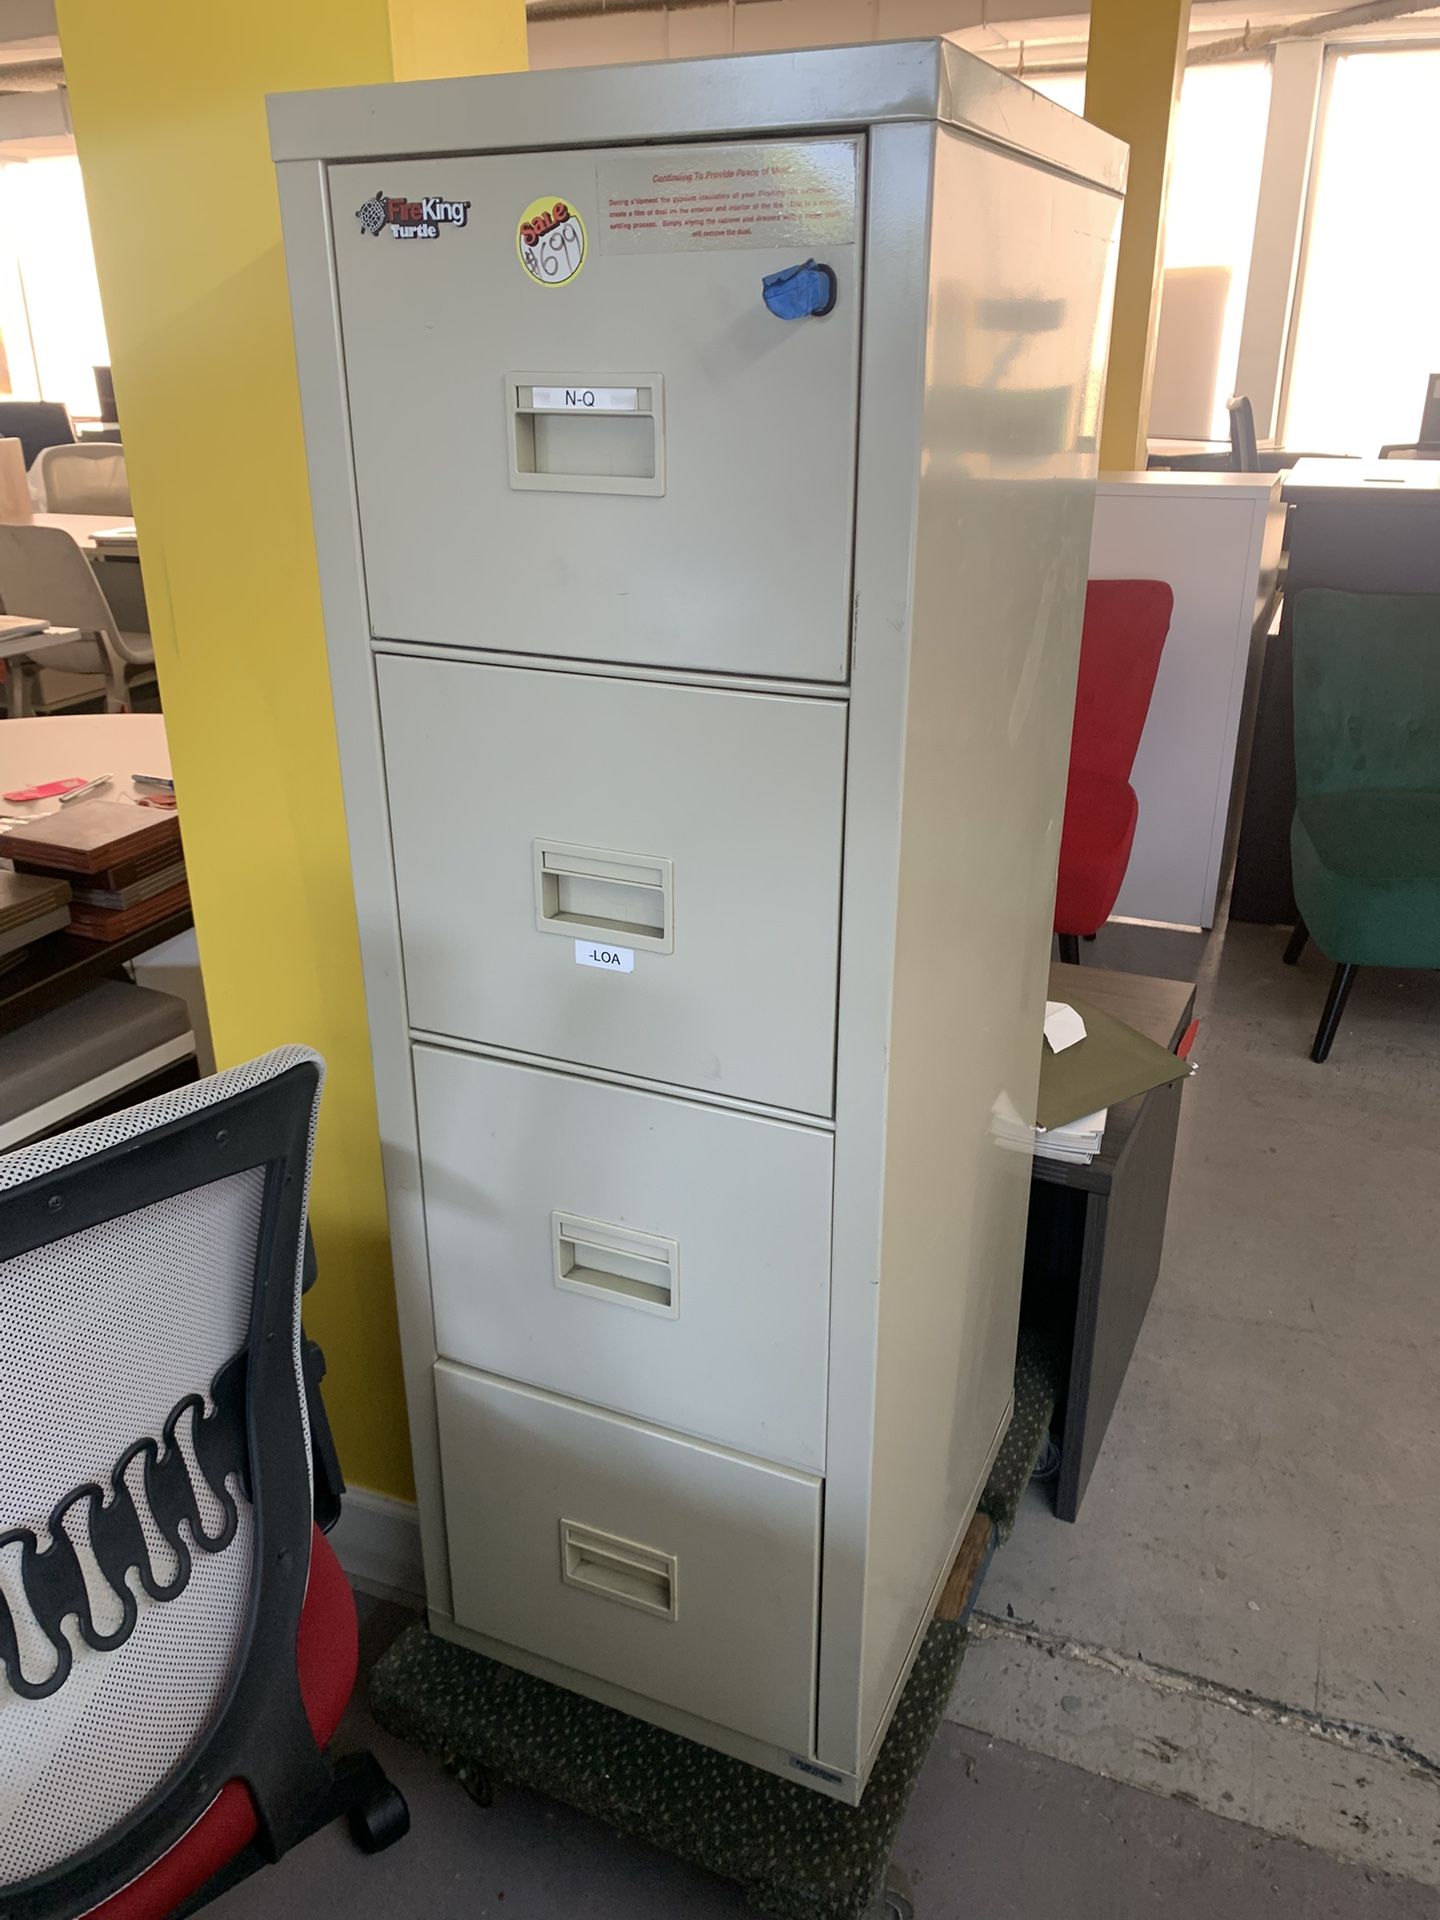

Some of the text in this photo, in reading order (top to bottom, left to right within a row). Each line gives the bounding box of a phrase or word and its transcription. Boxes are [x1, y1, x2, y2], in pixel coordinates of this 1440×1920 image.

[705, 169, 734, 179] Provide
[386, 197, 465, 227] FireKing
[390, 223, 439, 239] Turtle
[520, 201, 570, 247] Sale
[525, 223, 582, 279] $699
[565, 390, 595, 407] N-Q
[589, 950, 621, 965] -LOA
